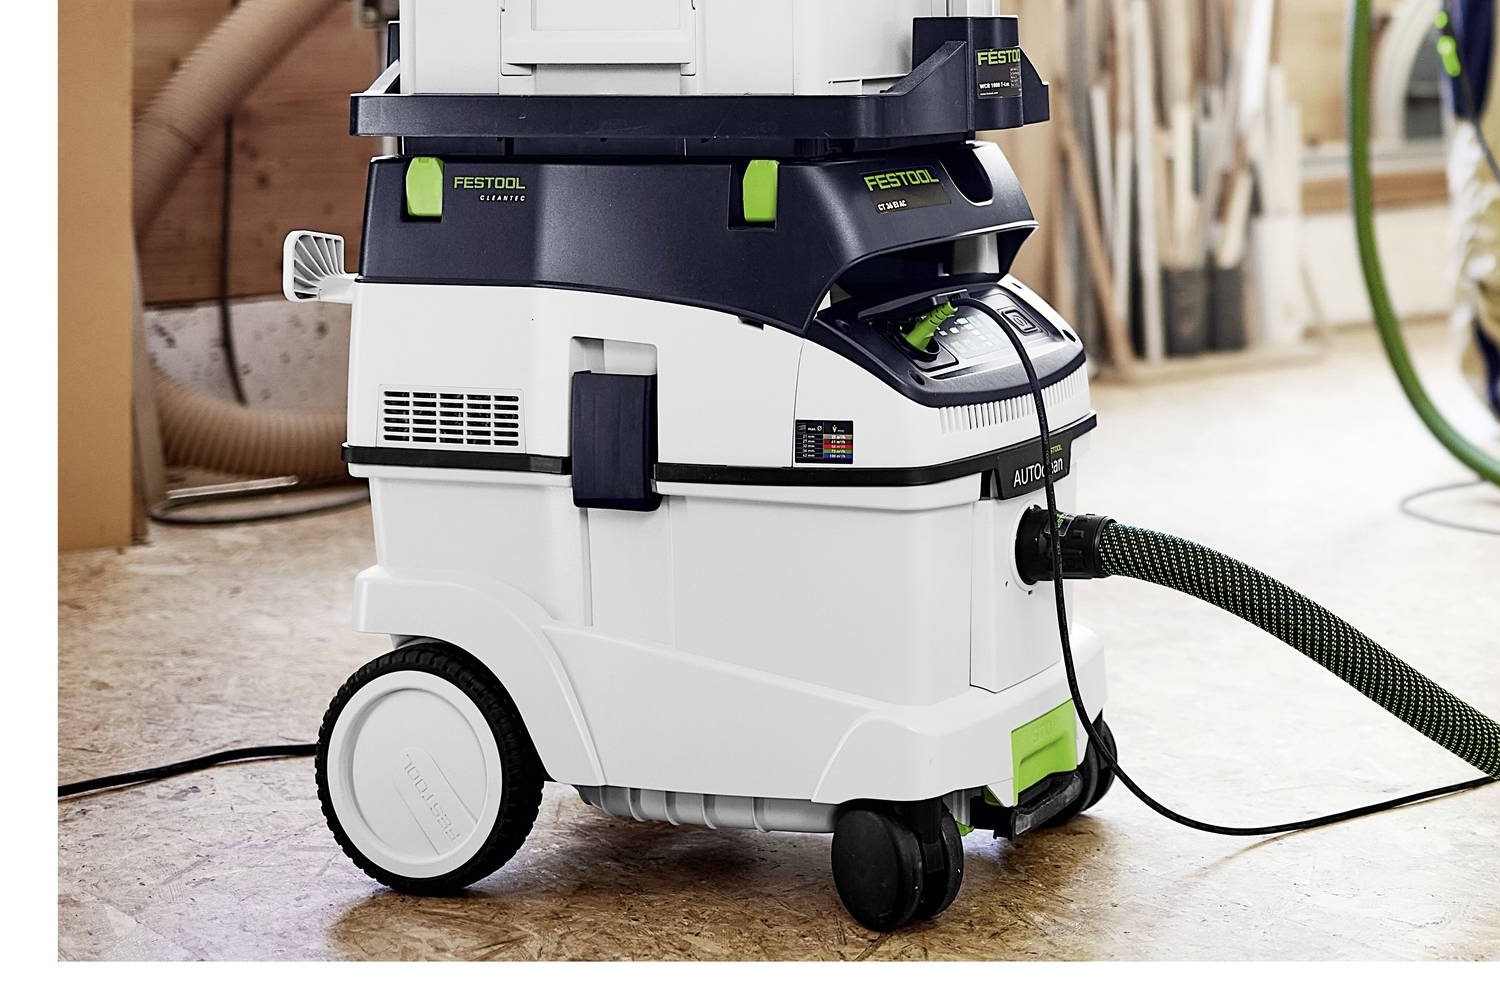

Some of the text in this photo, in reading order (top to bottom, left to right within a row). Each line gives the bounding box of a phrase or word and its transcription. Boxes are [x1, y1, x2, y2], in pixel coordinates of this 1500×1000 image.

[977, 48, 1021, 66] FESTOO
[453, 176, 526, 190] FESTOOL
[863, 168, 940, 192] FESTOOL
[479, 194, 526, 202] CLEANTEC
[877, 203, 886, 211] CT
[1013, 457, 1063, 488] AUTOcan
